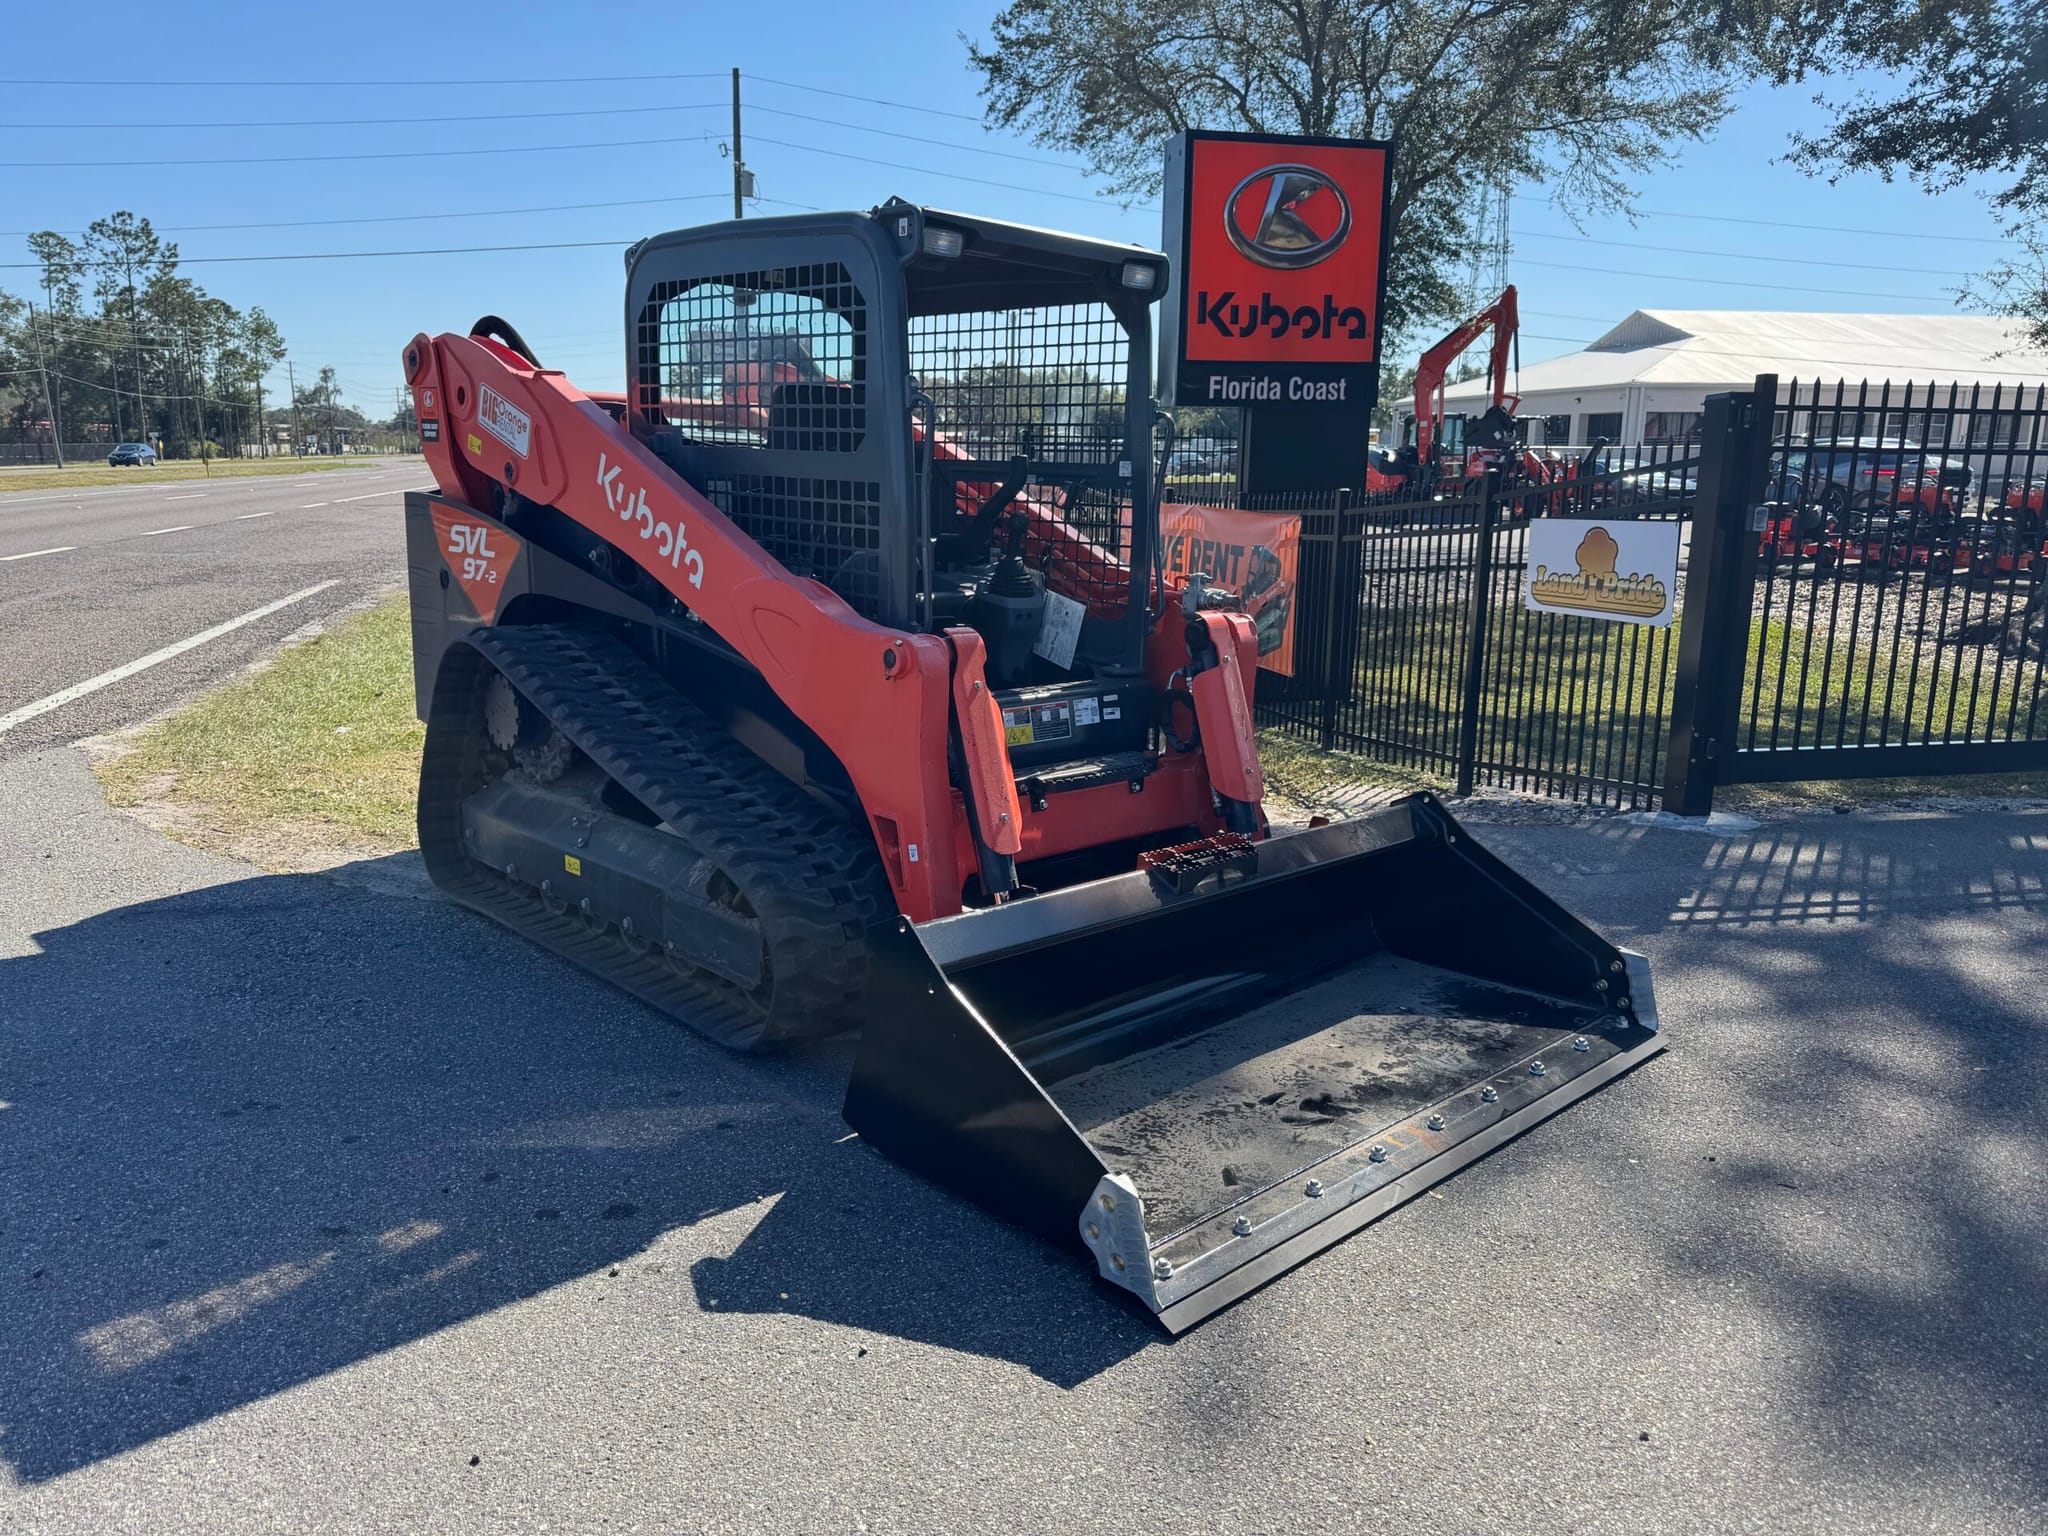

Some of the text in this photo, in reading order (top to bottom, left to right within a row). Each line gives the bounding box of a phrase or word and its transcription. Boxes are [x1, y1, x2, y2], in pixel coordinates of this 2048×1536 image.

[1197, 291, 1366, 340] Kubota
[1208, 375, 1346, 402] Florida Coast
[481, 389, 499, 424] BIG
[498, 400, 528, 434] Orange
[448, 524, 496, 558] SVL
[597, 452, 704, 590] Kubota
[462, 560, 497, 584] 97-2
[1189, 538, 1245, 586] RENT
[1534, 565, 1666, 604] Land Pride
